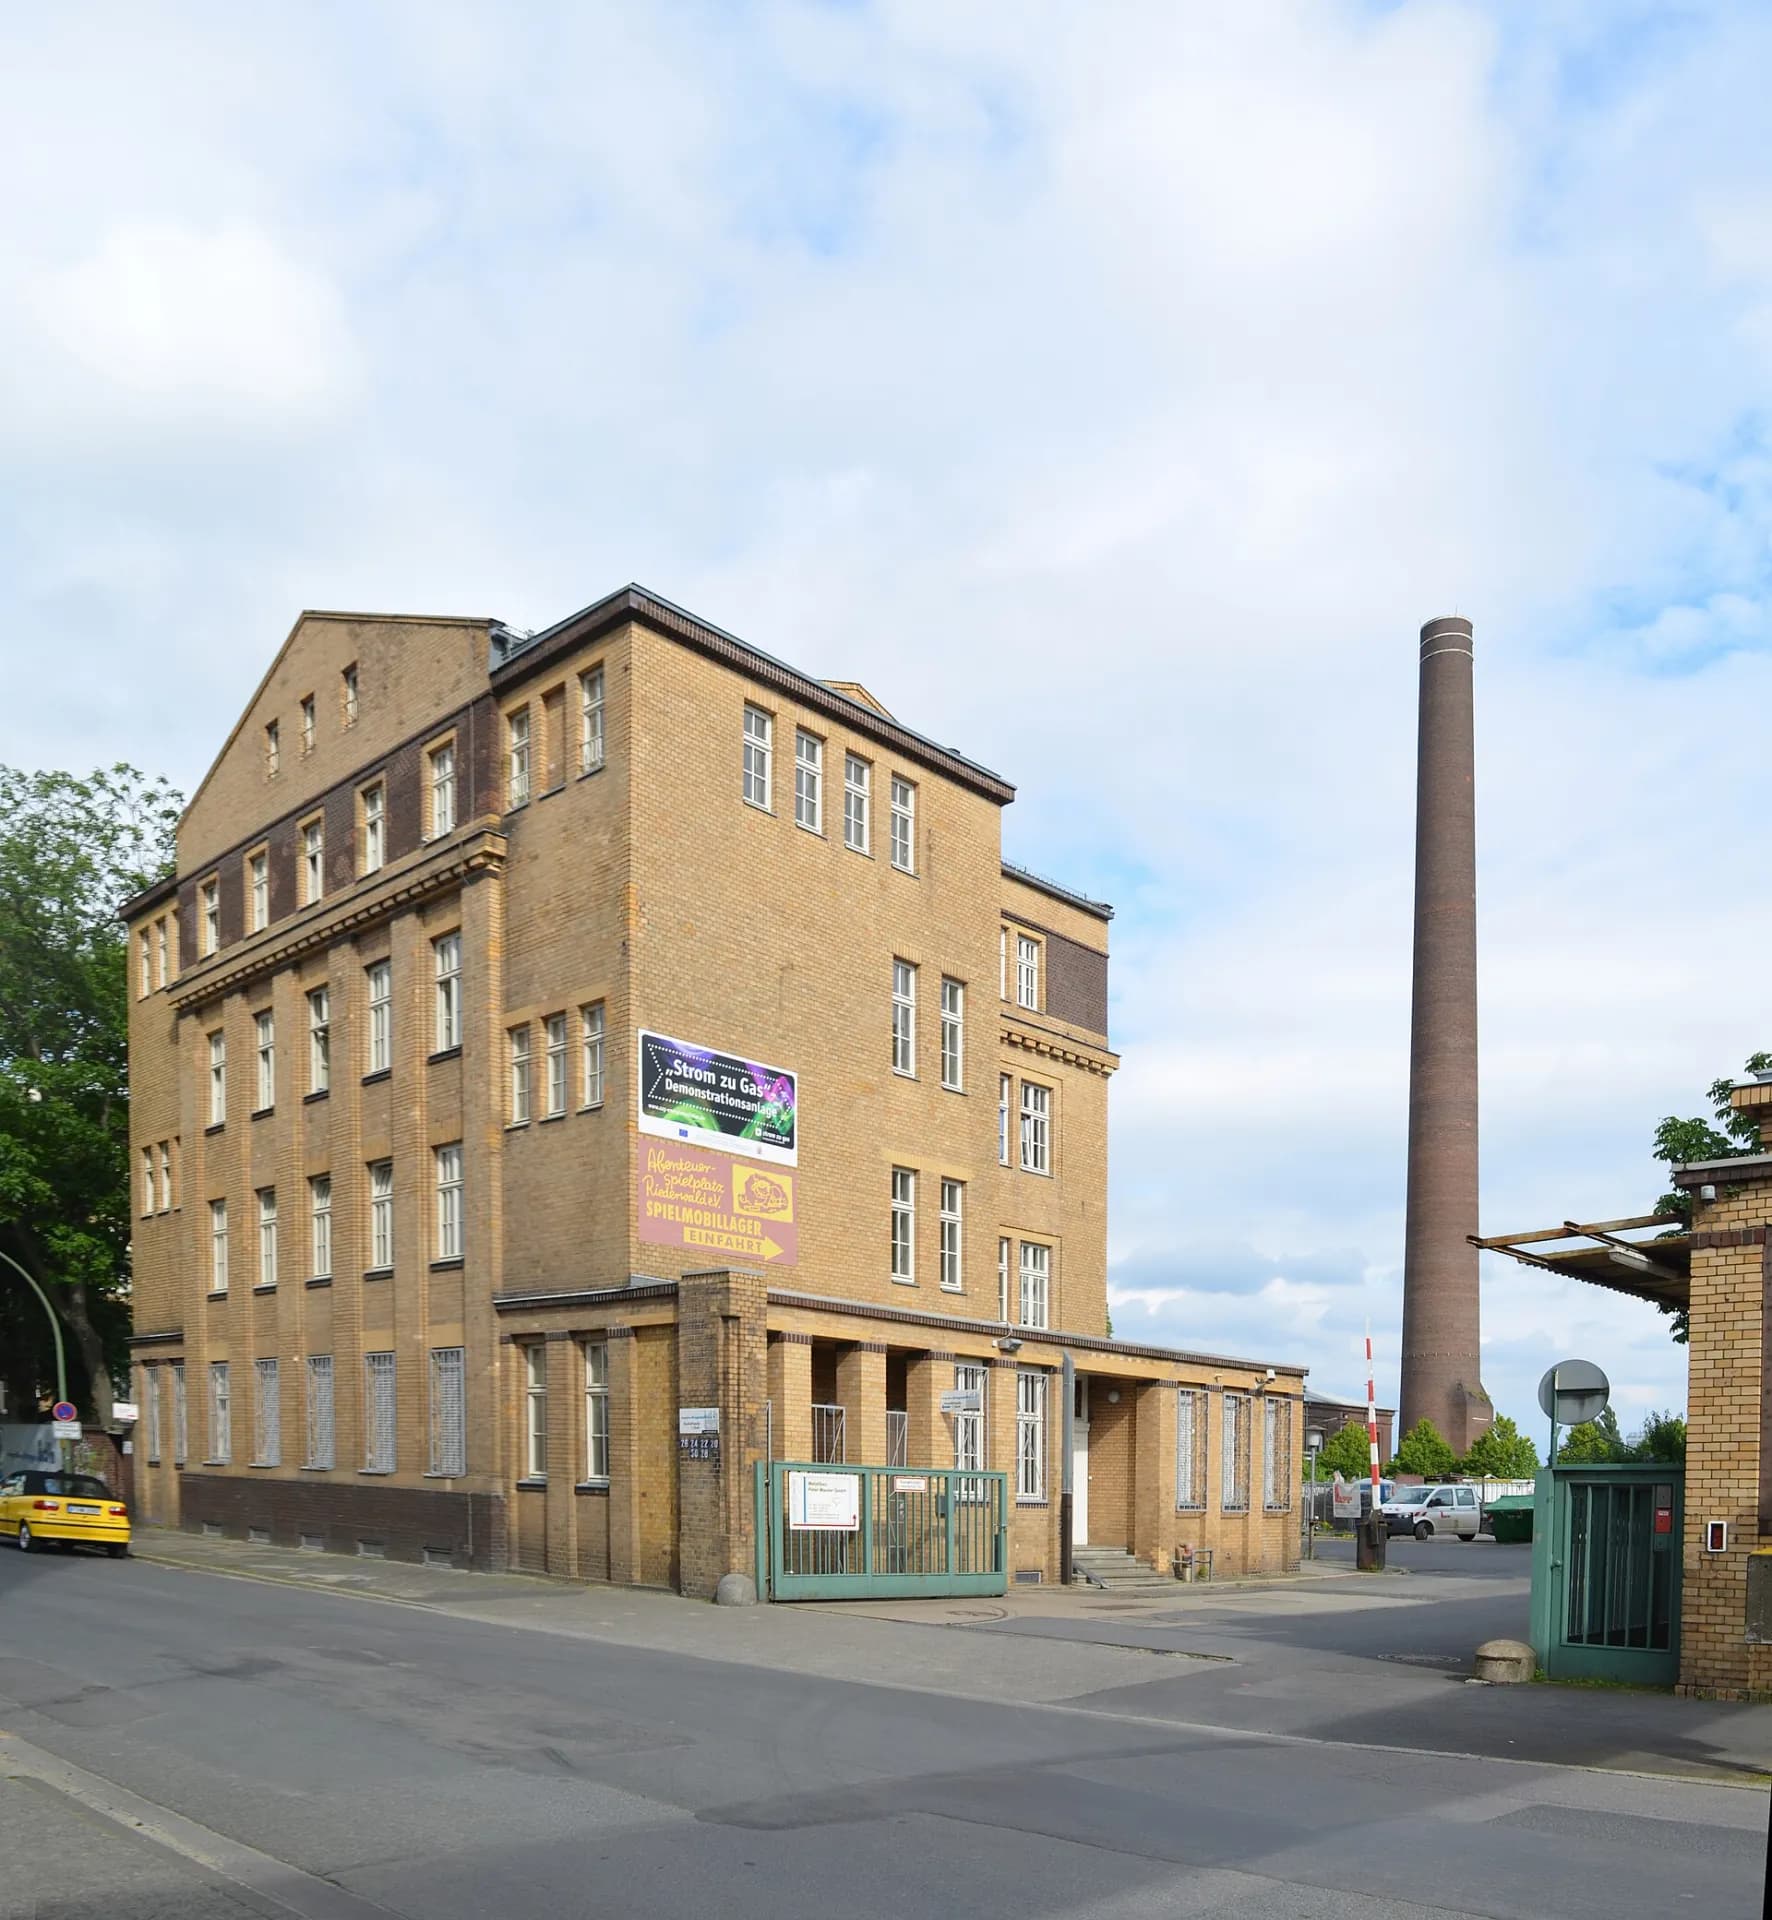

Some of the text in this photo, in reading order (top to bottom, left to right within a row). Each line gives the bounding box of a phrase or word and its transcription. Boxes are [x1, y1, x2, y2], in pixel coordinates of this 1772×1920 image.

[720, 1074, 736, 1091] zu
[665, 1078, 777, 1119] Demonstrationsanlage
[642, 1174, 707, 1205] Riederwald
[646, 1200, 762, 1237] SPIELMOBILLAGER
[689, 1230, 762, 1253] EINFAHRT
